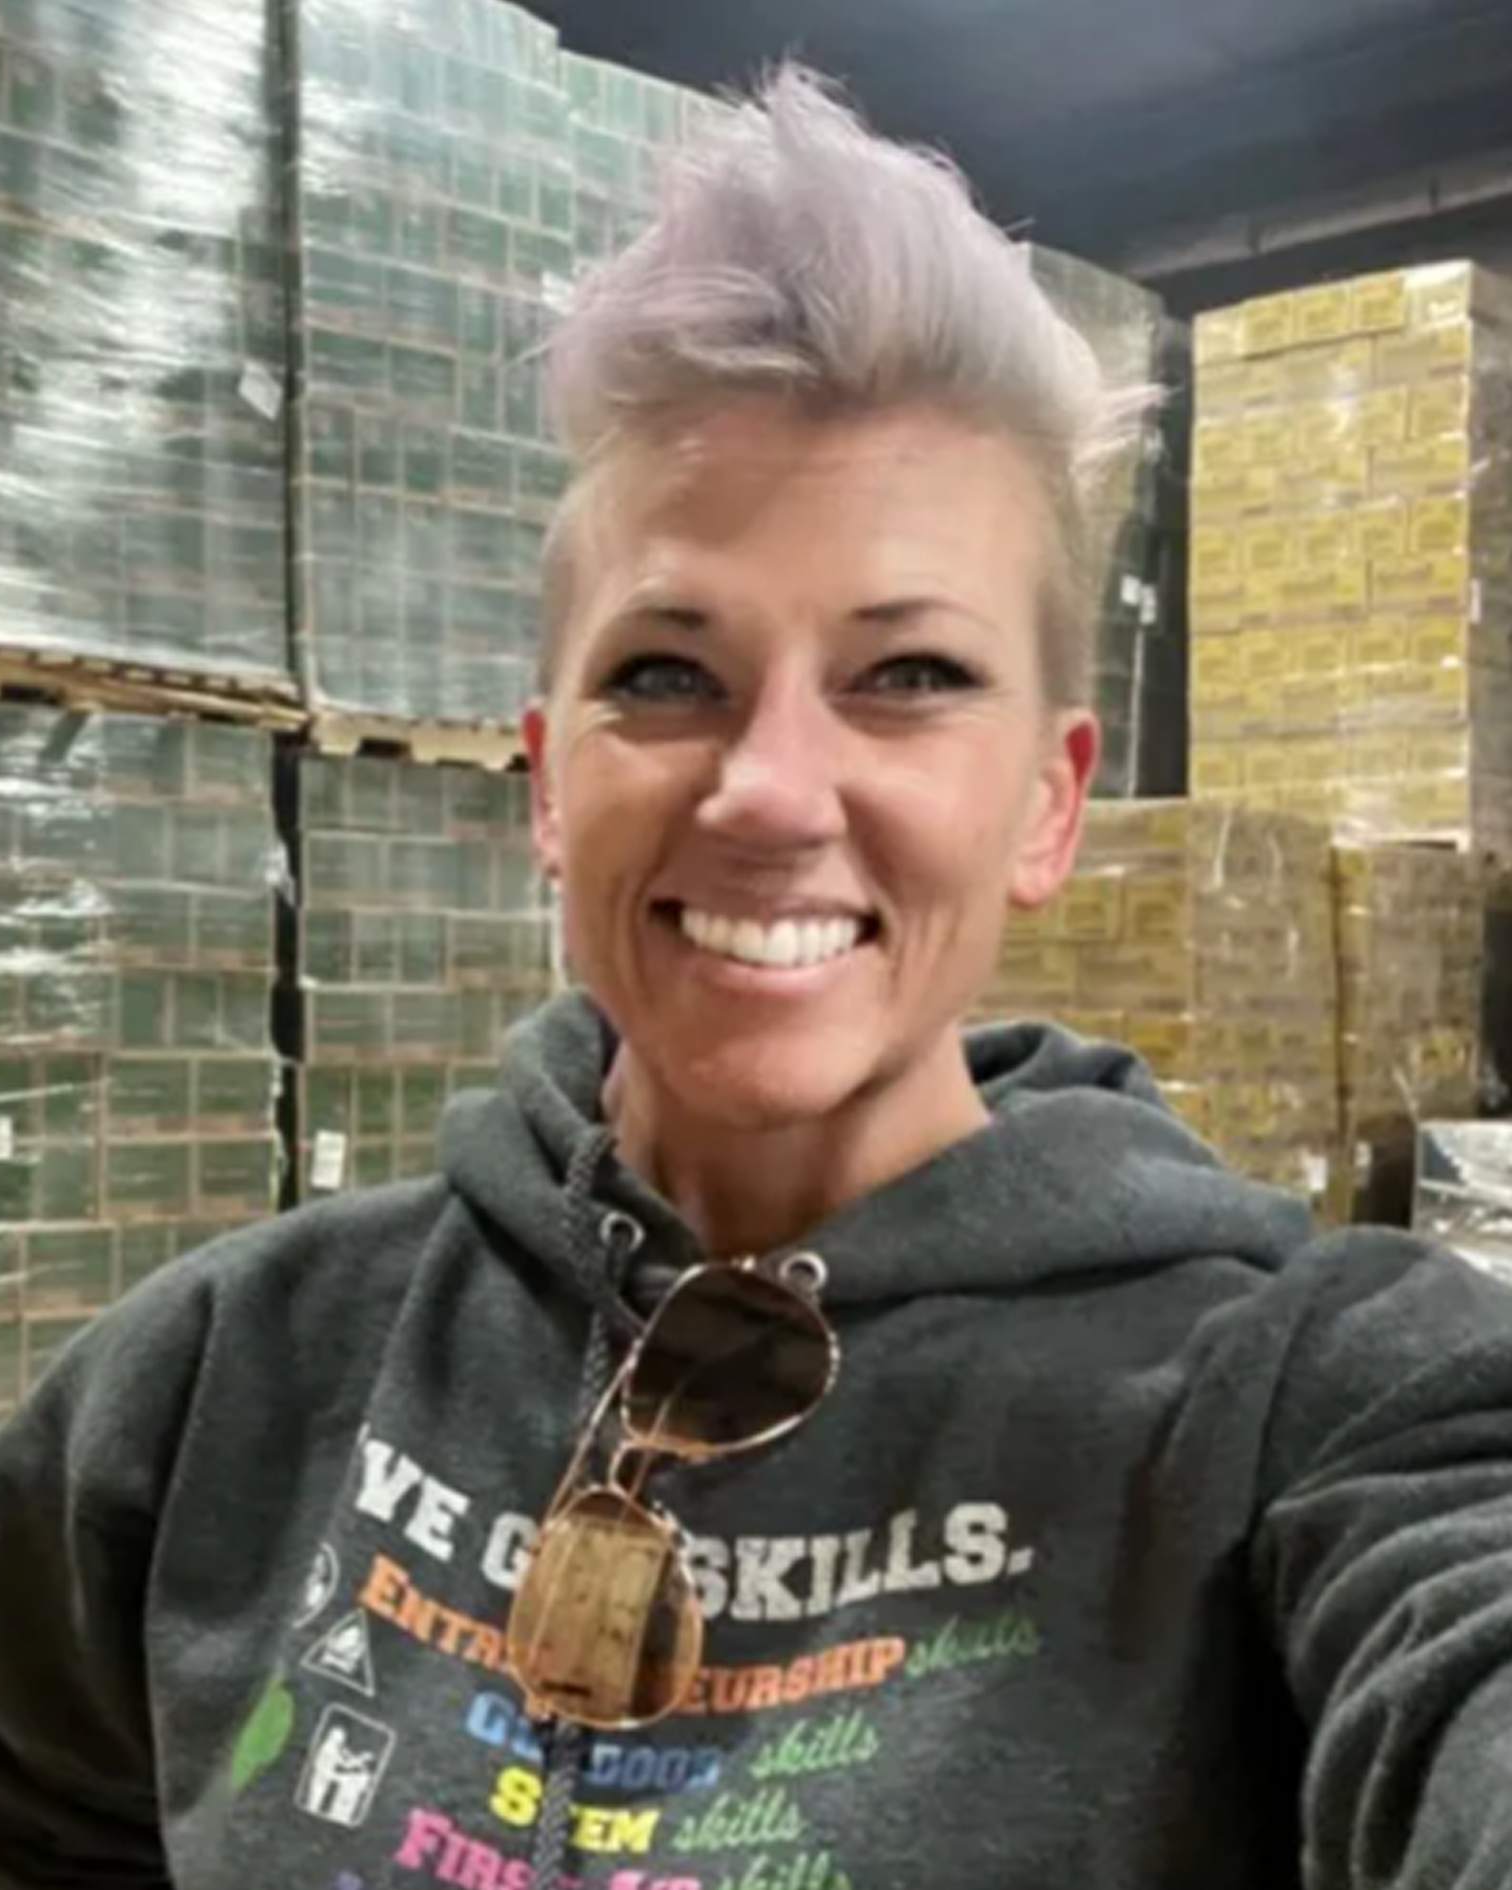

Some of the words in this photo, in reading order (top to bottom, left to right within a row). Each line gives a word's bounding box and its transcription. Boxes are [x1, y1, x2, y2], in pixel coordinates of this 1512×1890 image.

[681, 1502, 1034, 1621] SKILLS.
[750, 1708, 879, 1778] skills
[490, 1765, 661, 1853] SEM
[672, 1787, 809, 1852] skills
